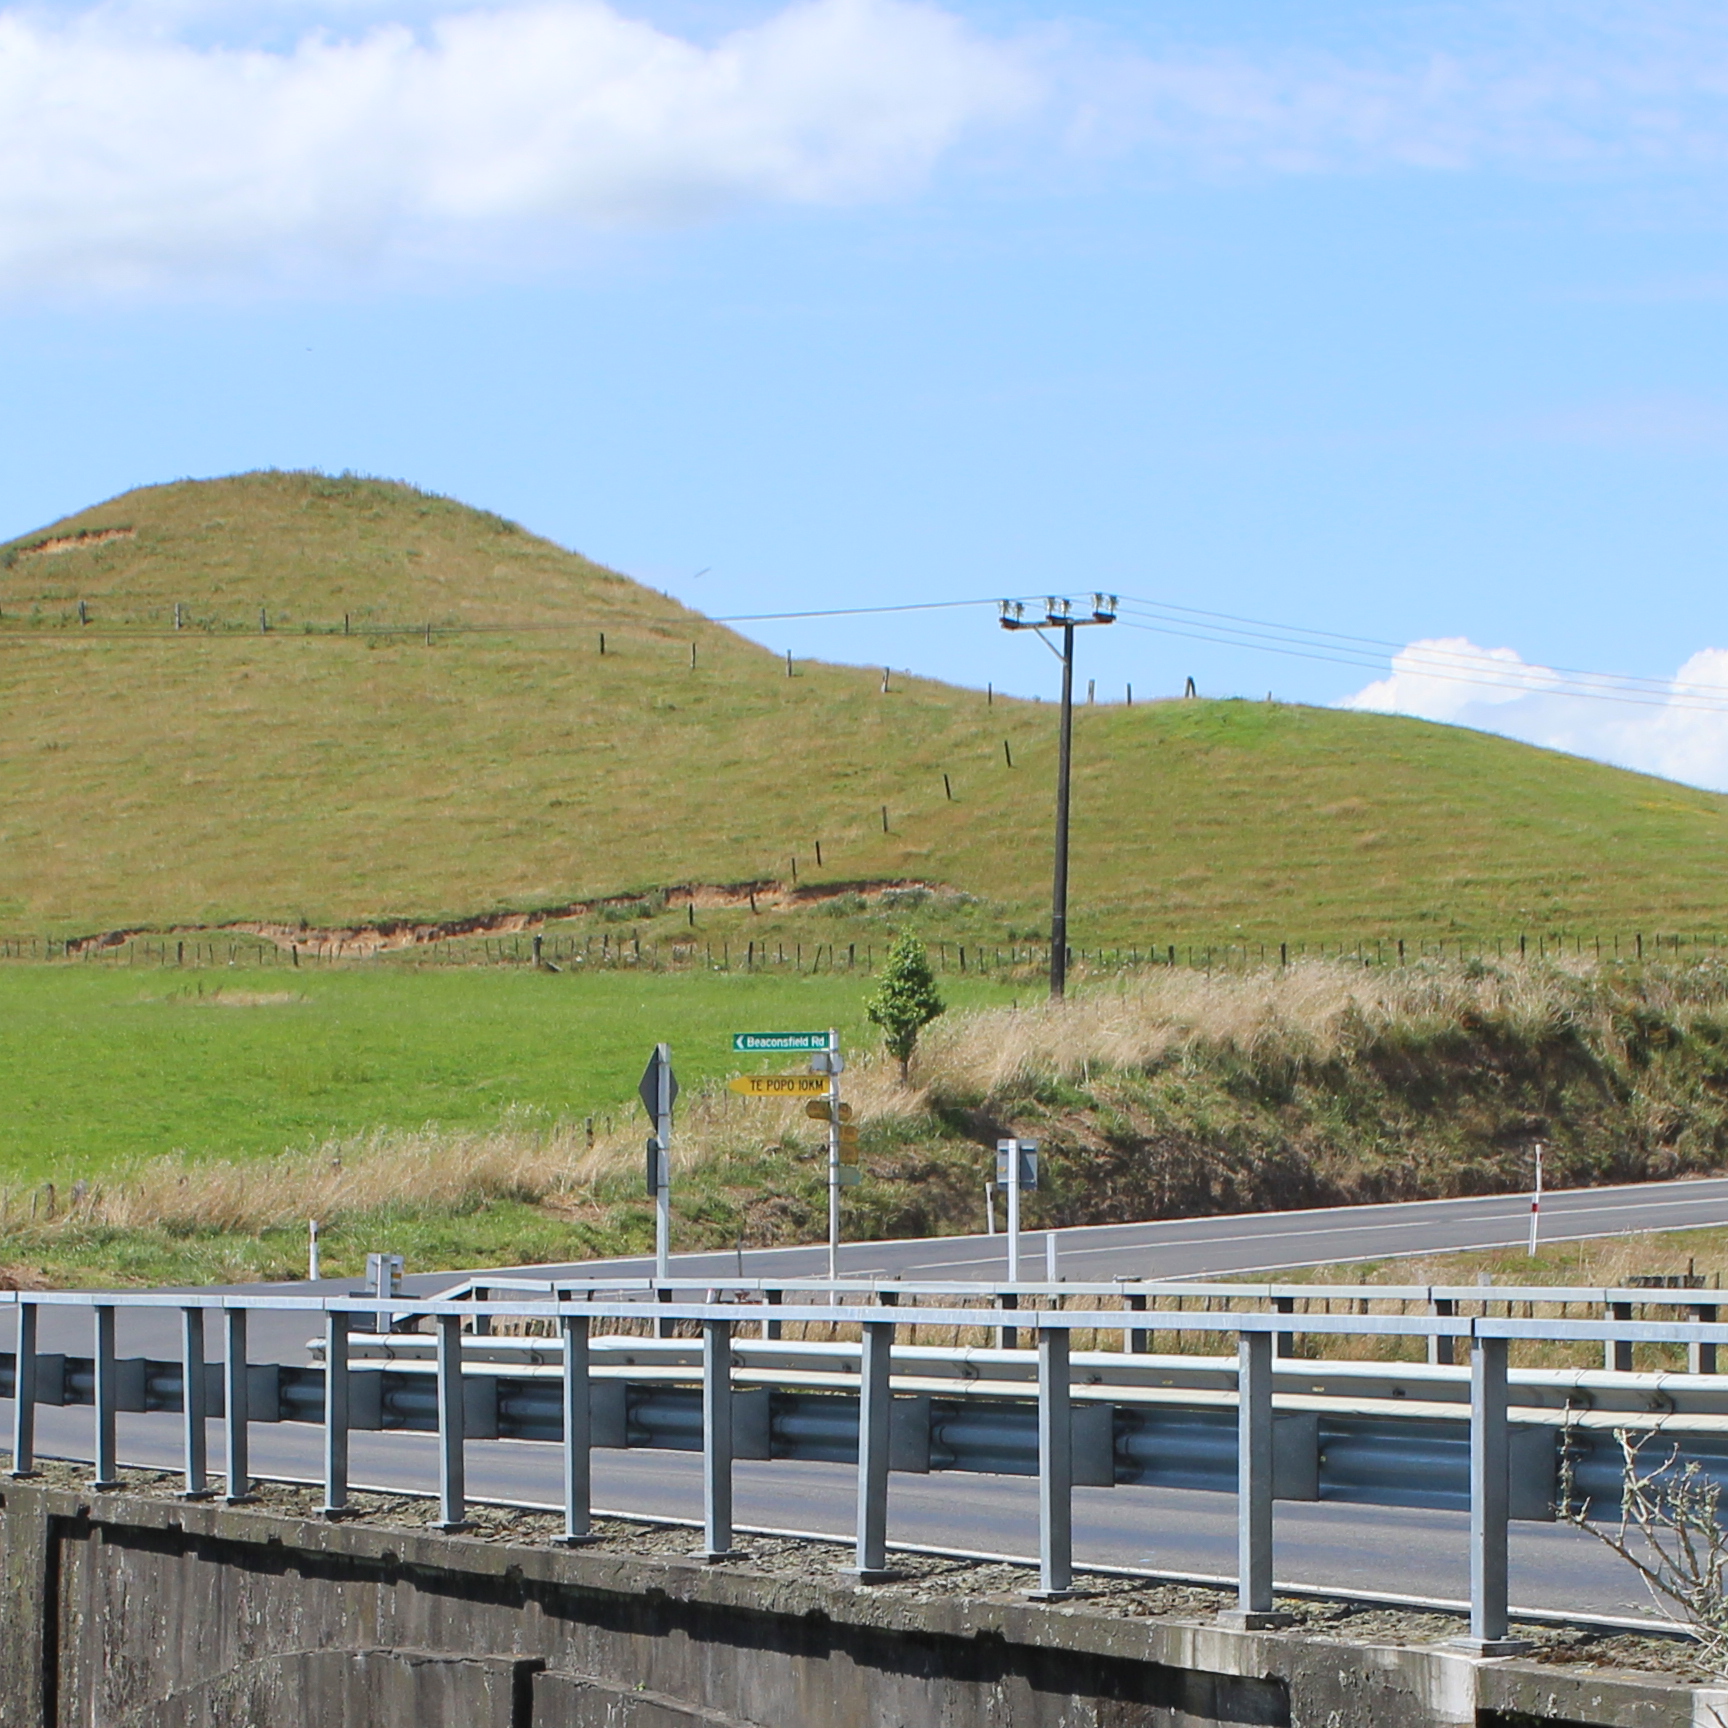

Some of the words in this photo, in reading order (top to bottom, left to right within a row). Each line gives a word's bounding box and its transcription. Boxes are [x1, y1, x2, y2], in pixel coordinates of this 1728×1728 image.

[746, 1035, 808, 1047] Beaconsfield
[811, 1035, 825, 1047] Rd
[750, 1079, 762, 1092] TE
[766, 1079, 795, 1092] POPO
[798, 1079, 824, 1092] 10KM
